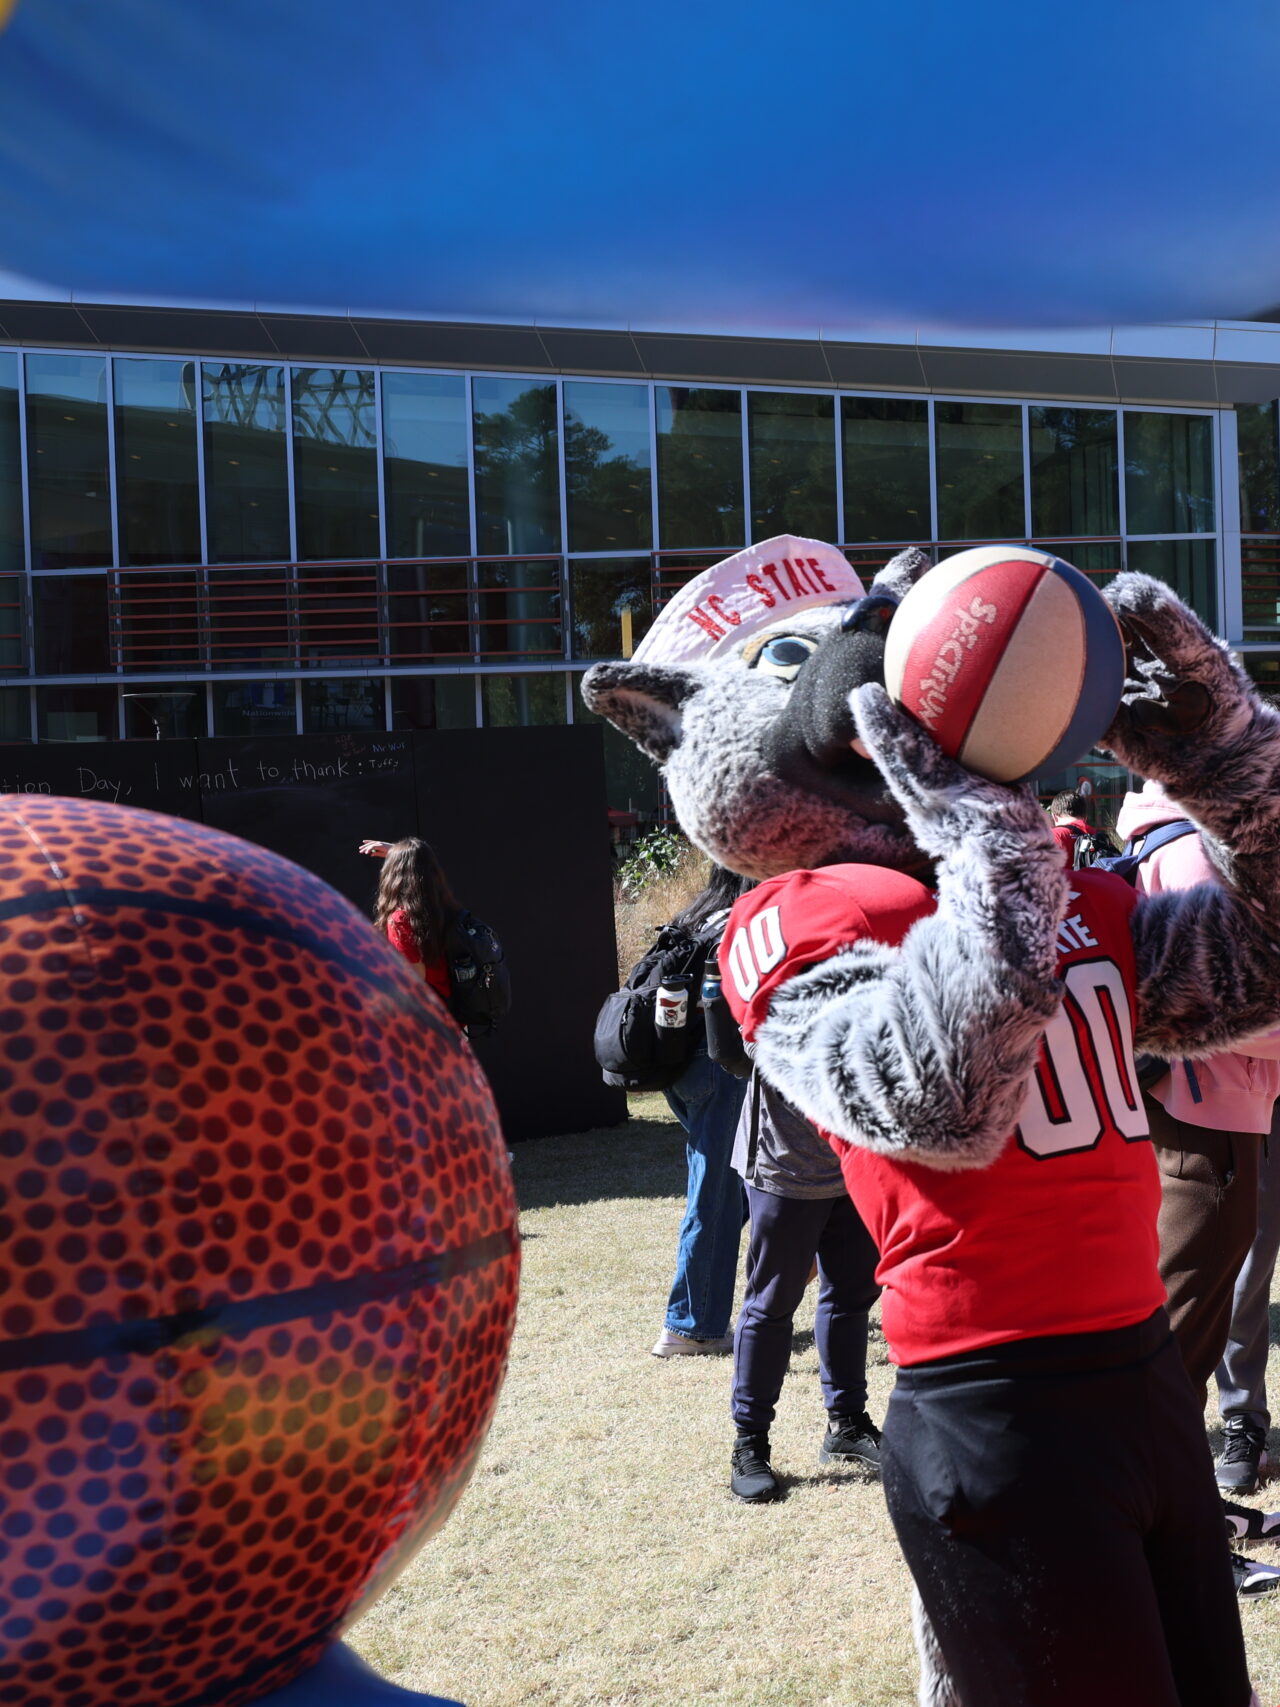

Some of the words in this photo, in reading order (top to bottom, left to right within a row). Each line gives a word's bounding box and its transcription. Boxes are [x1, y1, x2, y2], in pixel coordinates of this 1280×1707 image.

[687, 594, 741, 642] NC
[746, 558, 836, 608] STATE
[77, 766, 132, 804] Day,
[179, 758, 239, 791] want
[256, 760, 280, 782] to
[728, 905, 788, 1003] 00
